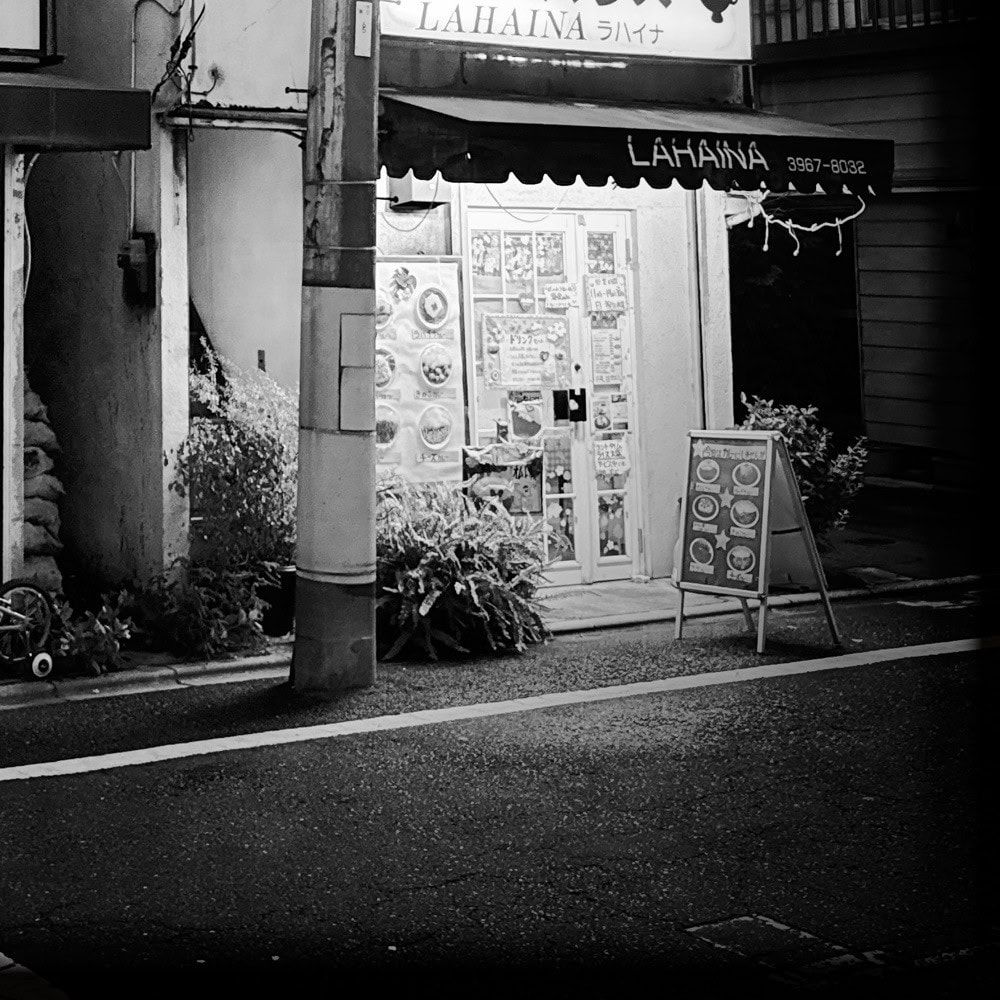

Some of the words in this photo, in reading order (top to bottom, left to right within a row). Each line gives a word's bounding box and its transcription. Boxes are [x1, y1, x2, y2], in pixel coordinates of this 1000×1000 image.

[415, 1, 587, 41] LAHAINA
[597, 19, 664, 45] ラハイナ
[627, 135, 770, 171] LAHAINA
